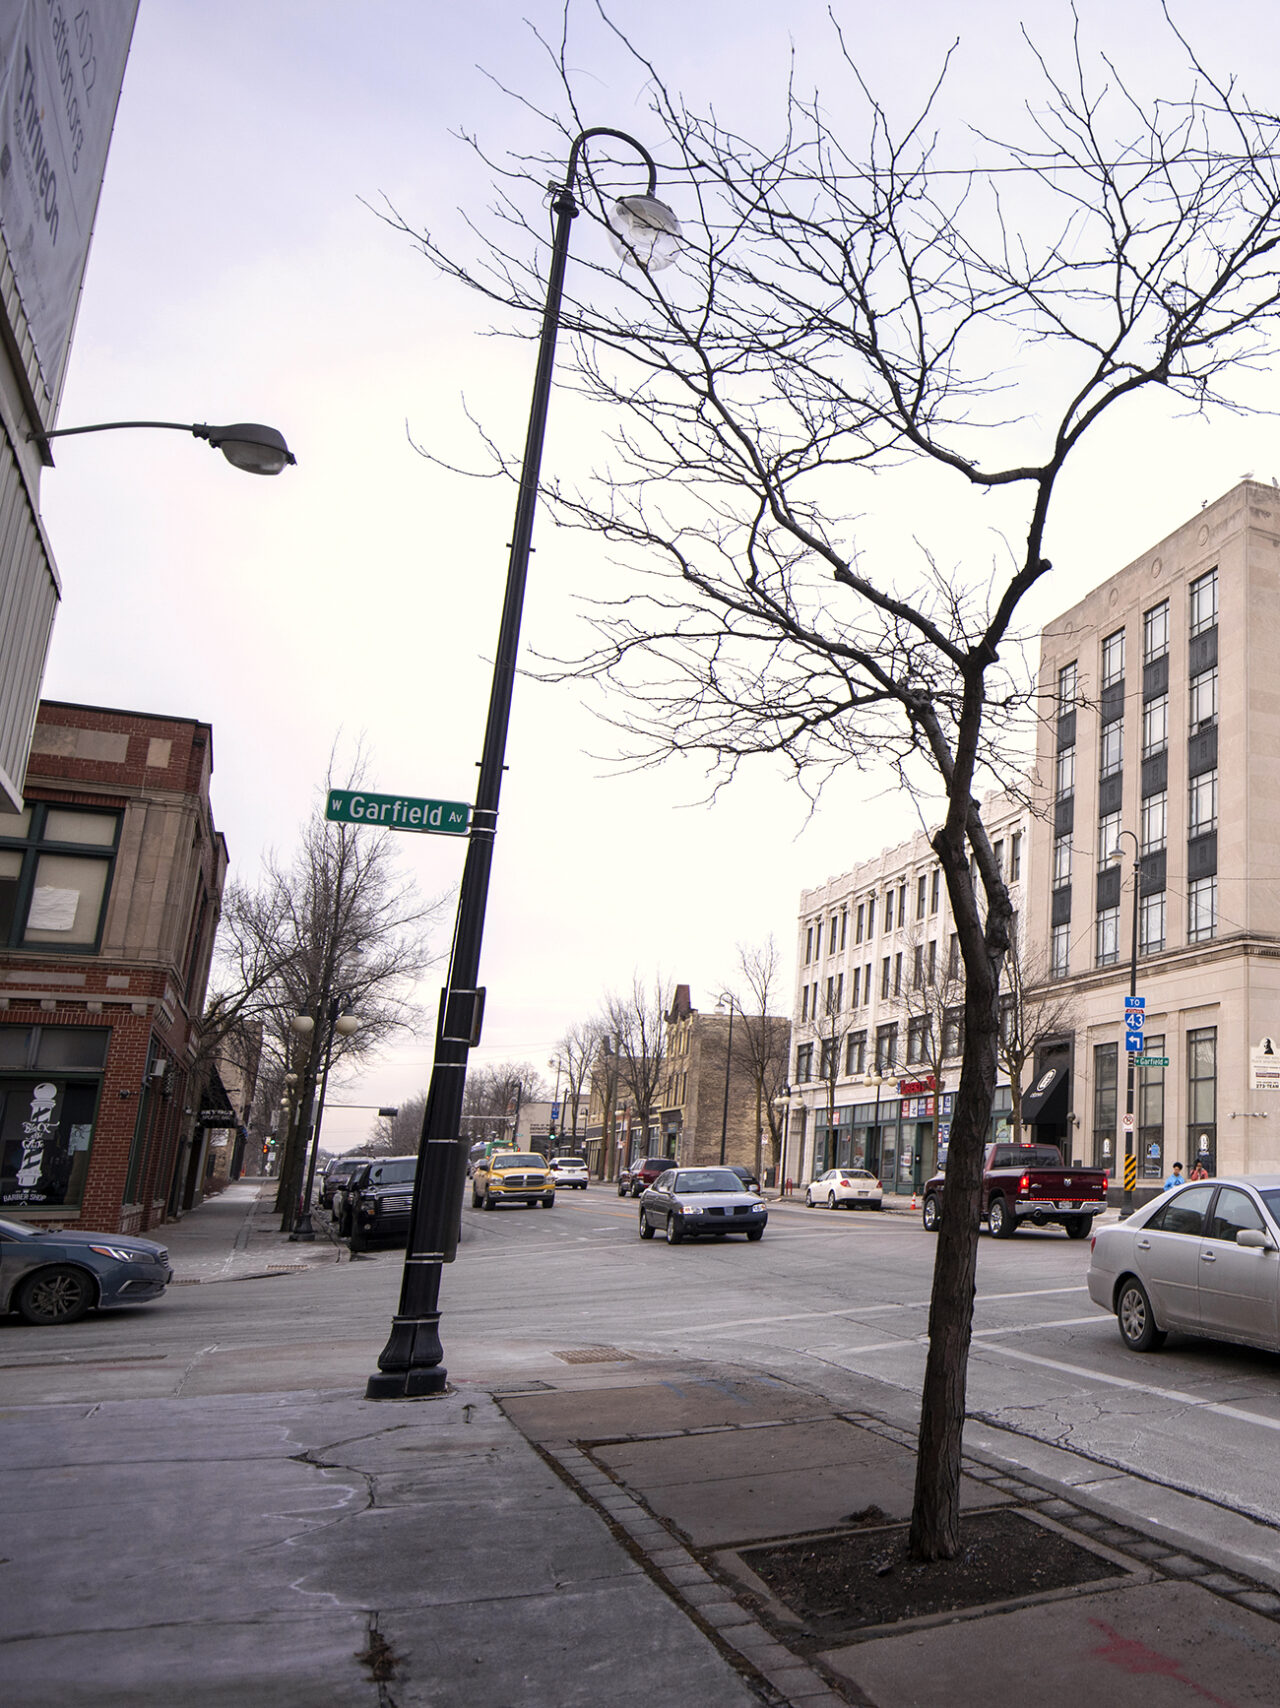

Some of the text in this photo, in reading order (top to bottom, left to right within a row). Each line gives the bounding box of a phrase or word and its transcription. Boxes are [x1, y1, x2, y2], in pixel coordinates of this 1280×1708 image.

[19, 43, 59, 247] ThriveOn
[332, 797, 463, 826] W Garfield Av
[1126, 1014, 1143, 1027] 43
[1140, 1057, 1163, 1066] Garfield
[3, 1193, 47, 1202] BARBER SHOP
